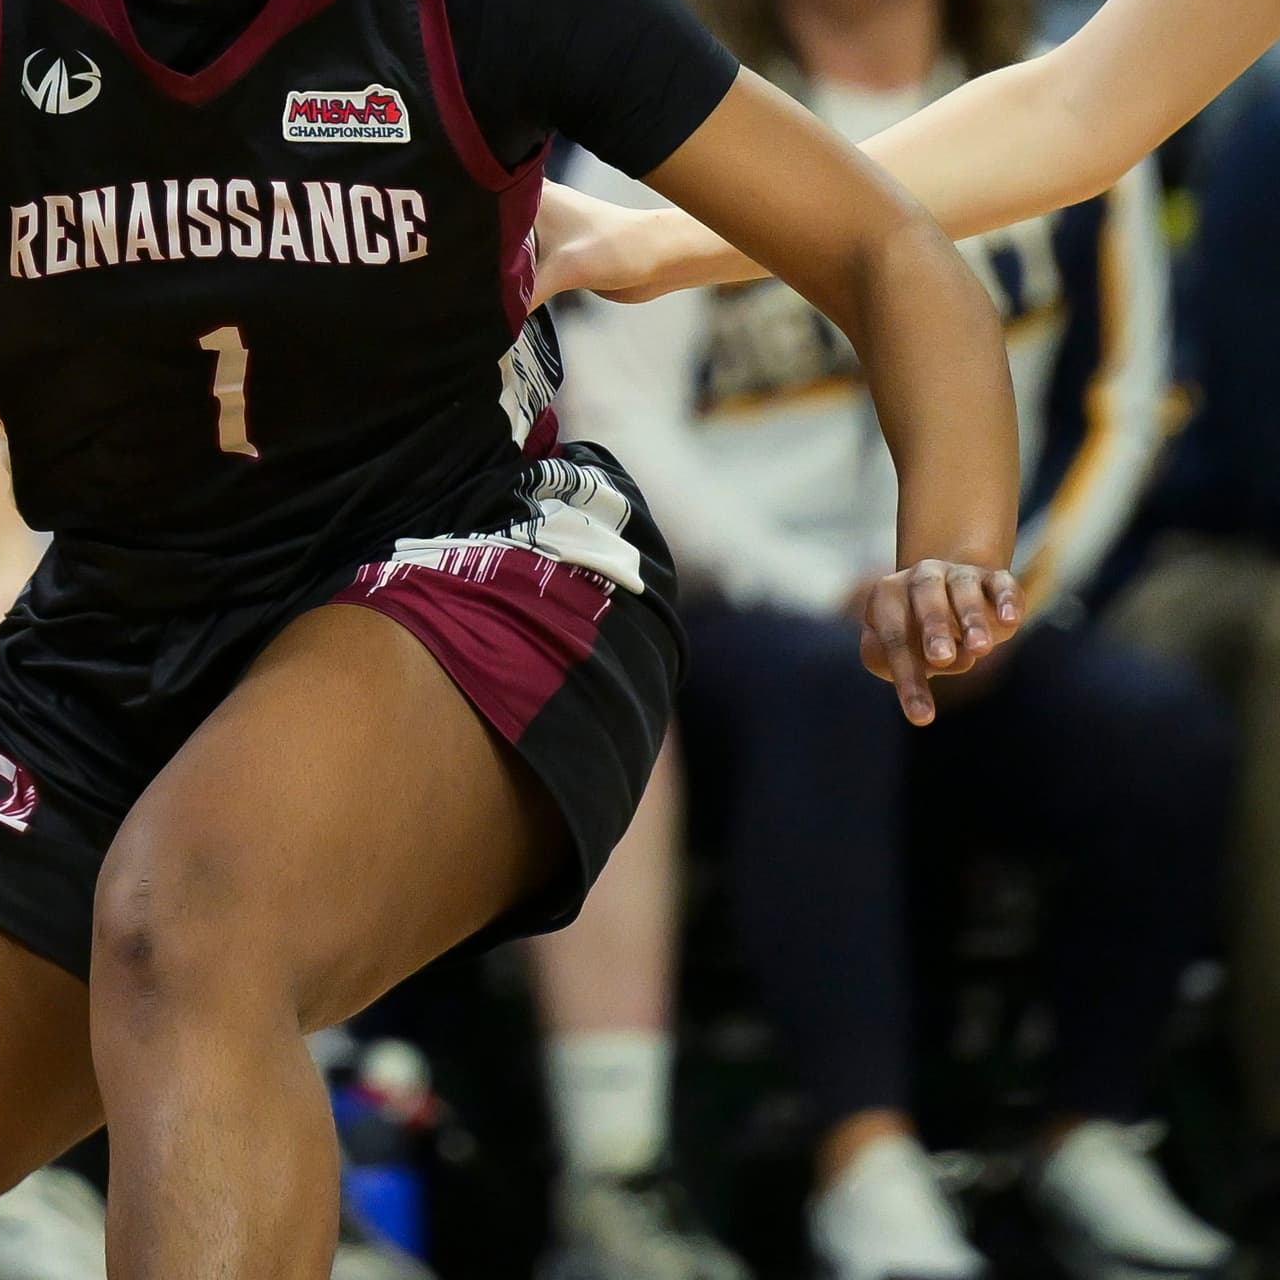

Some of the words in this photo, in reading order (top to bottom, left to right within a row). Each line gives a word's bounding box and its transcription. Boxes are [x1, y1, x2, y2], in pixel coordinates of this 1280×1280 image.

[288, 126, 405, 138] CHAMPIONSHIPS
[10, 178, 429, 278] RENAISSANCE
[198, 326, 260, 458] 1
